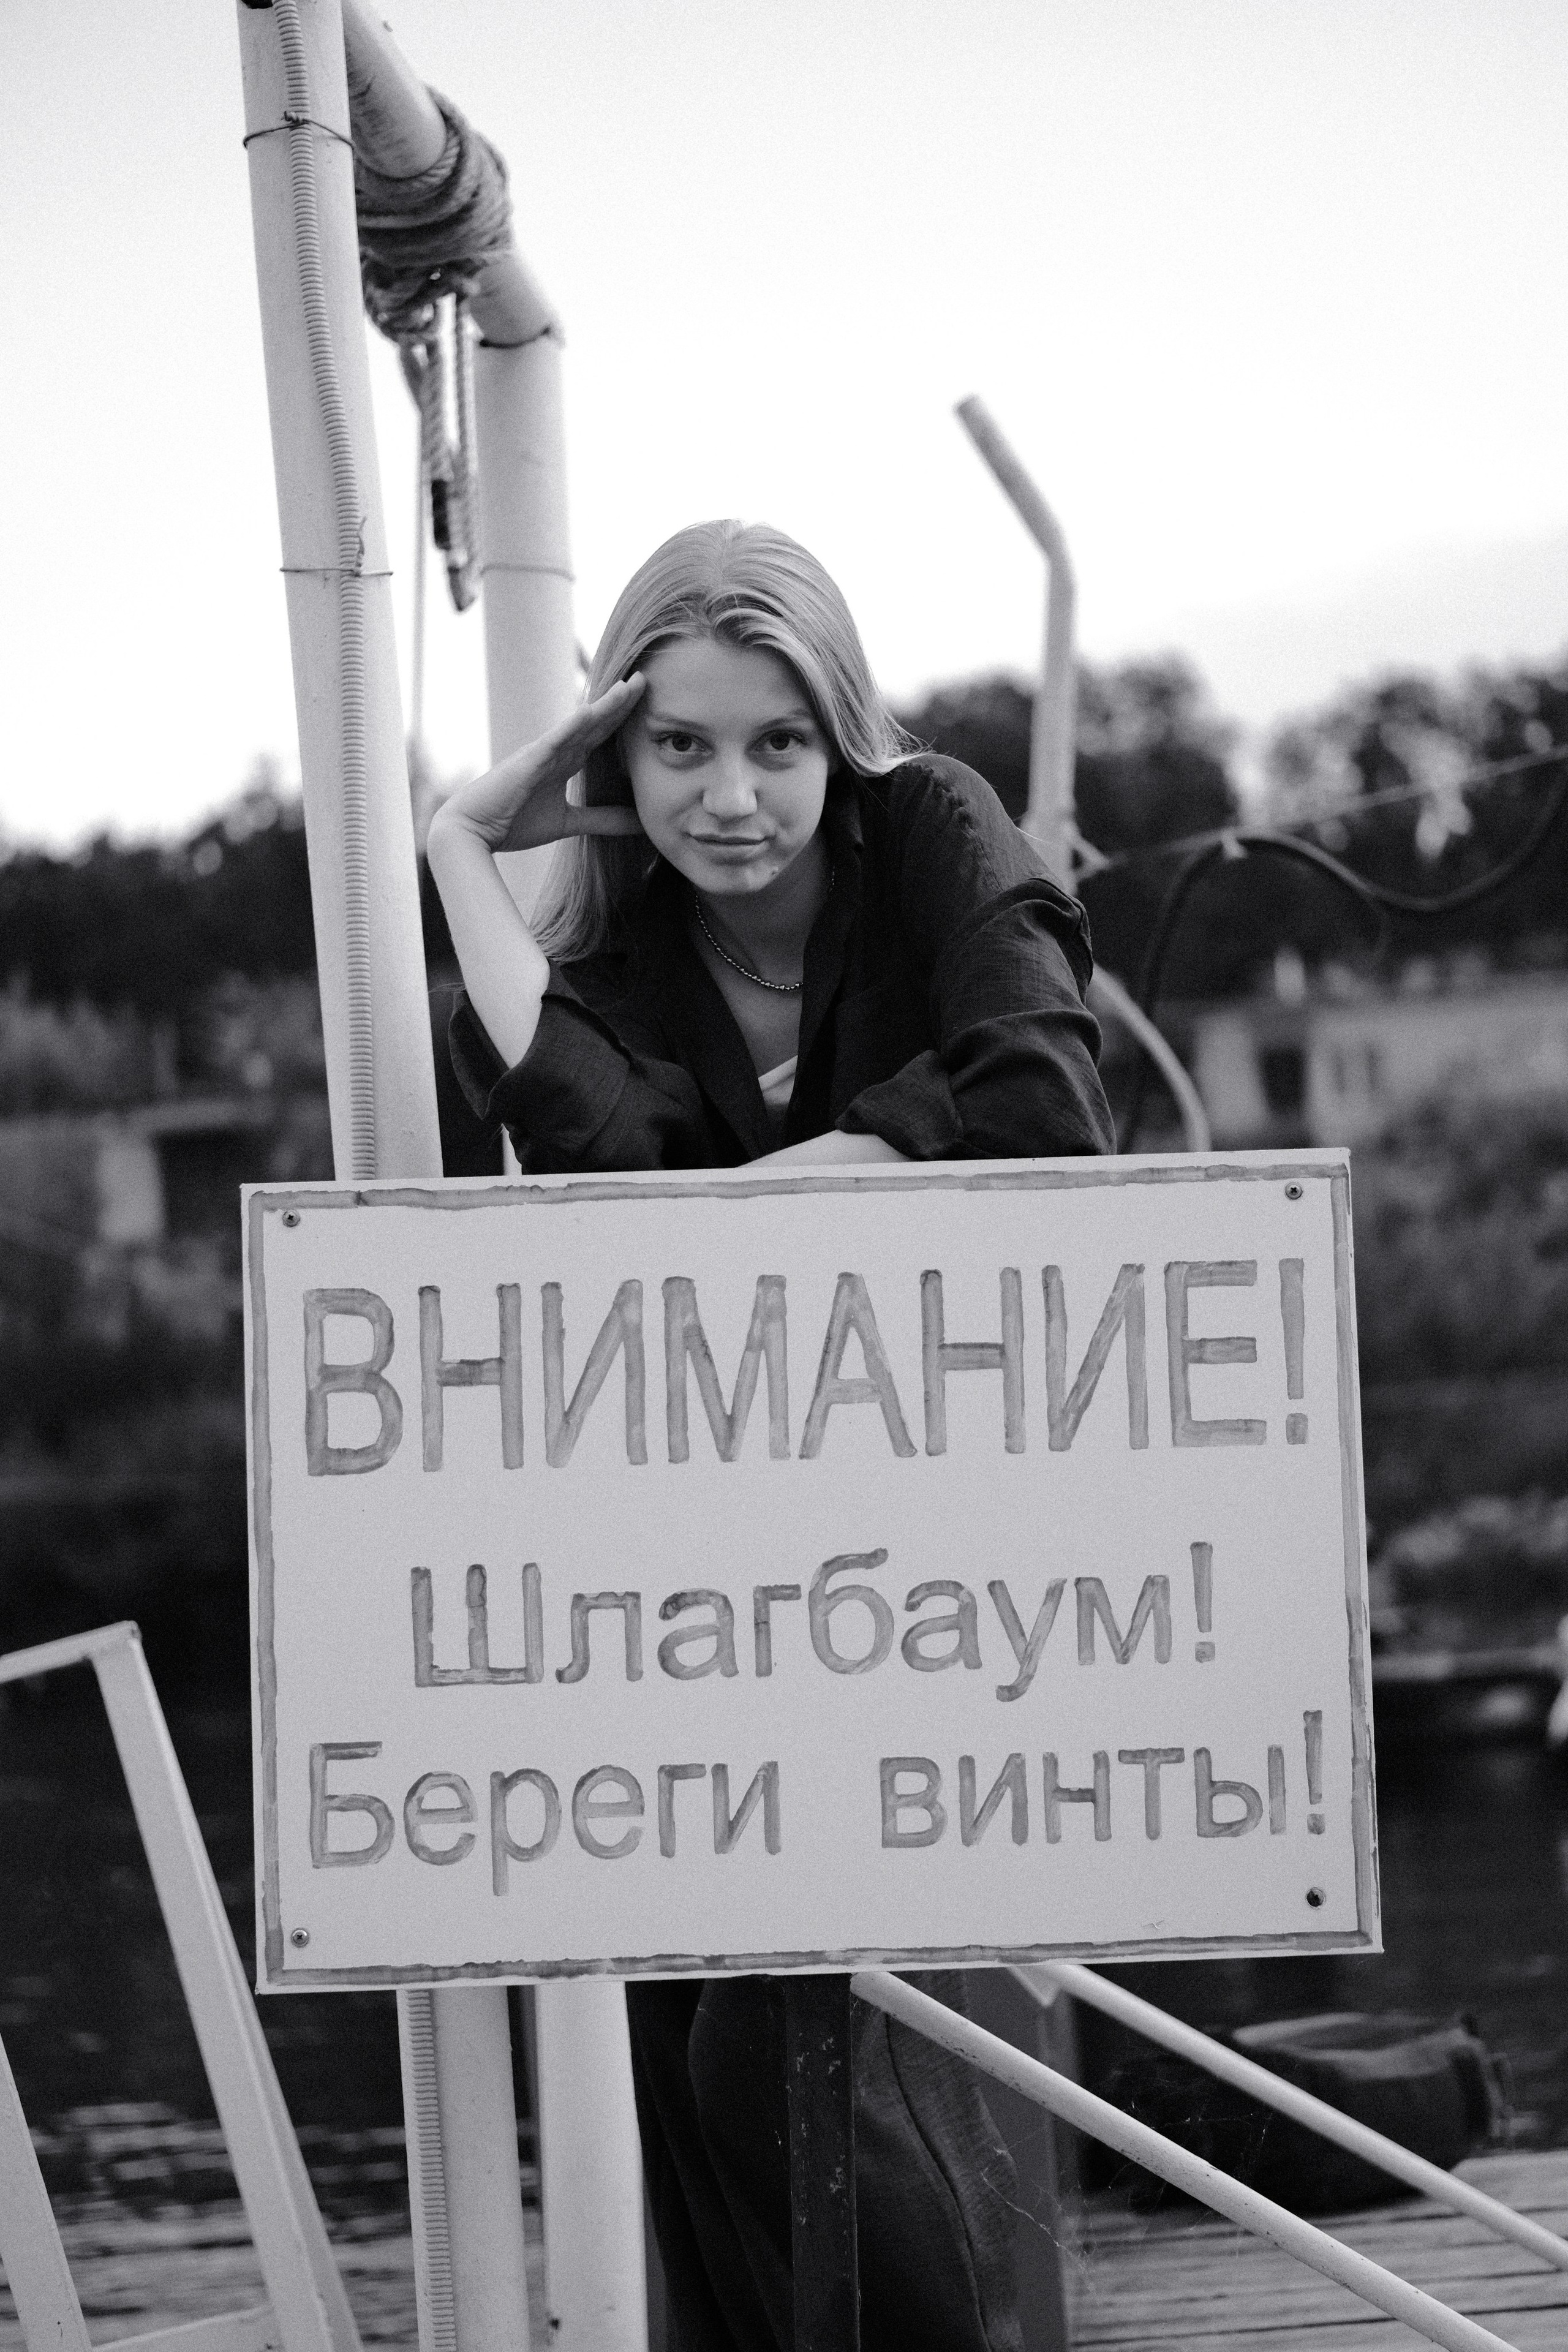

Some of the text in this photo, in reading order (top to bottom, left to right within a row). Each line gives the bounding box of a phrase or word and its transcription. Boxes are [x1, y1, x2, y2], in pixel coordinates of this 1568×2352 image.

[306, 1257, 1310, 1477] ВНИМАНИЕ!
[410, 1541, 1217, 1702] Шлагбаум!
[309, 1709, 1325, 1896] Береги винты!
